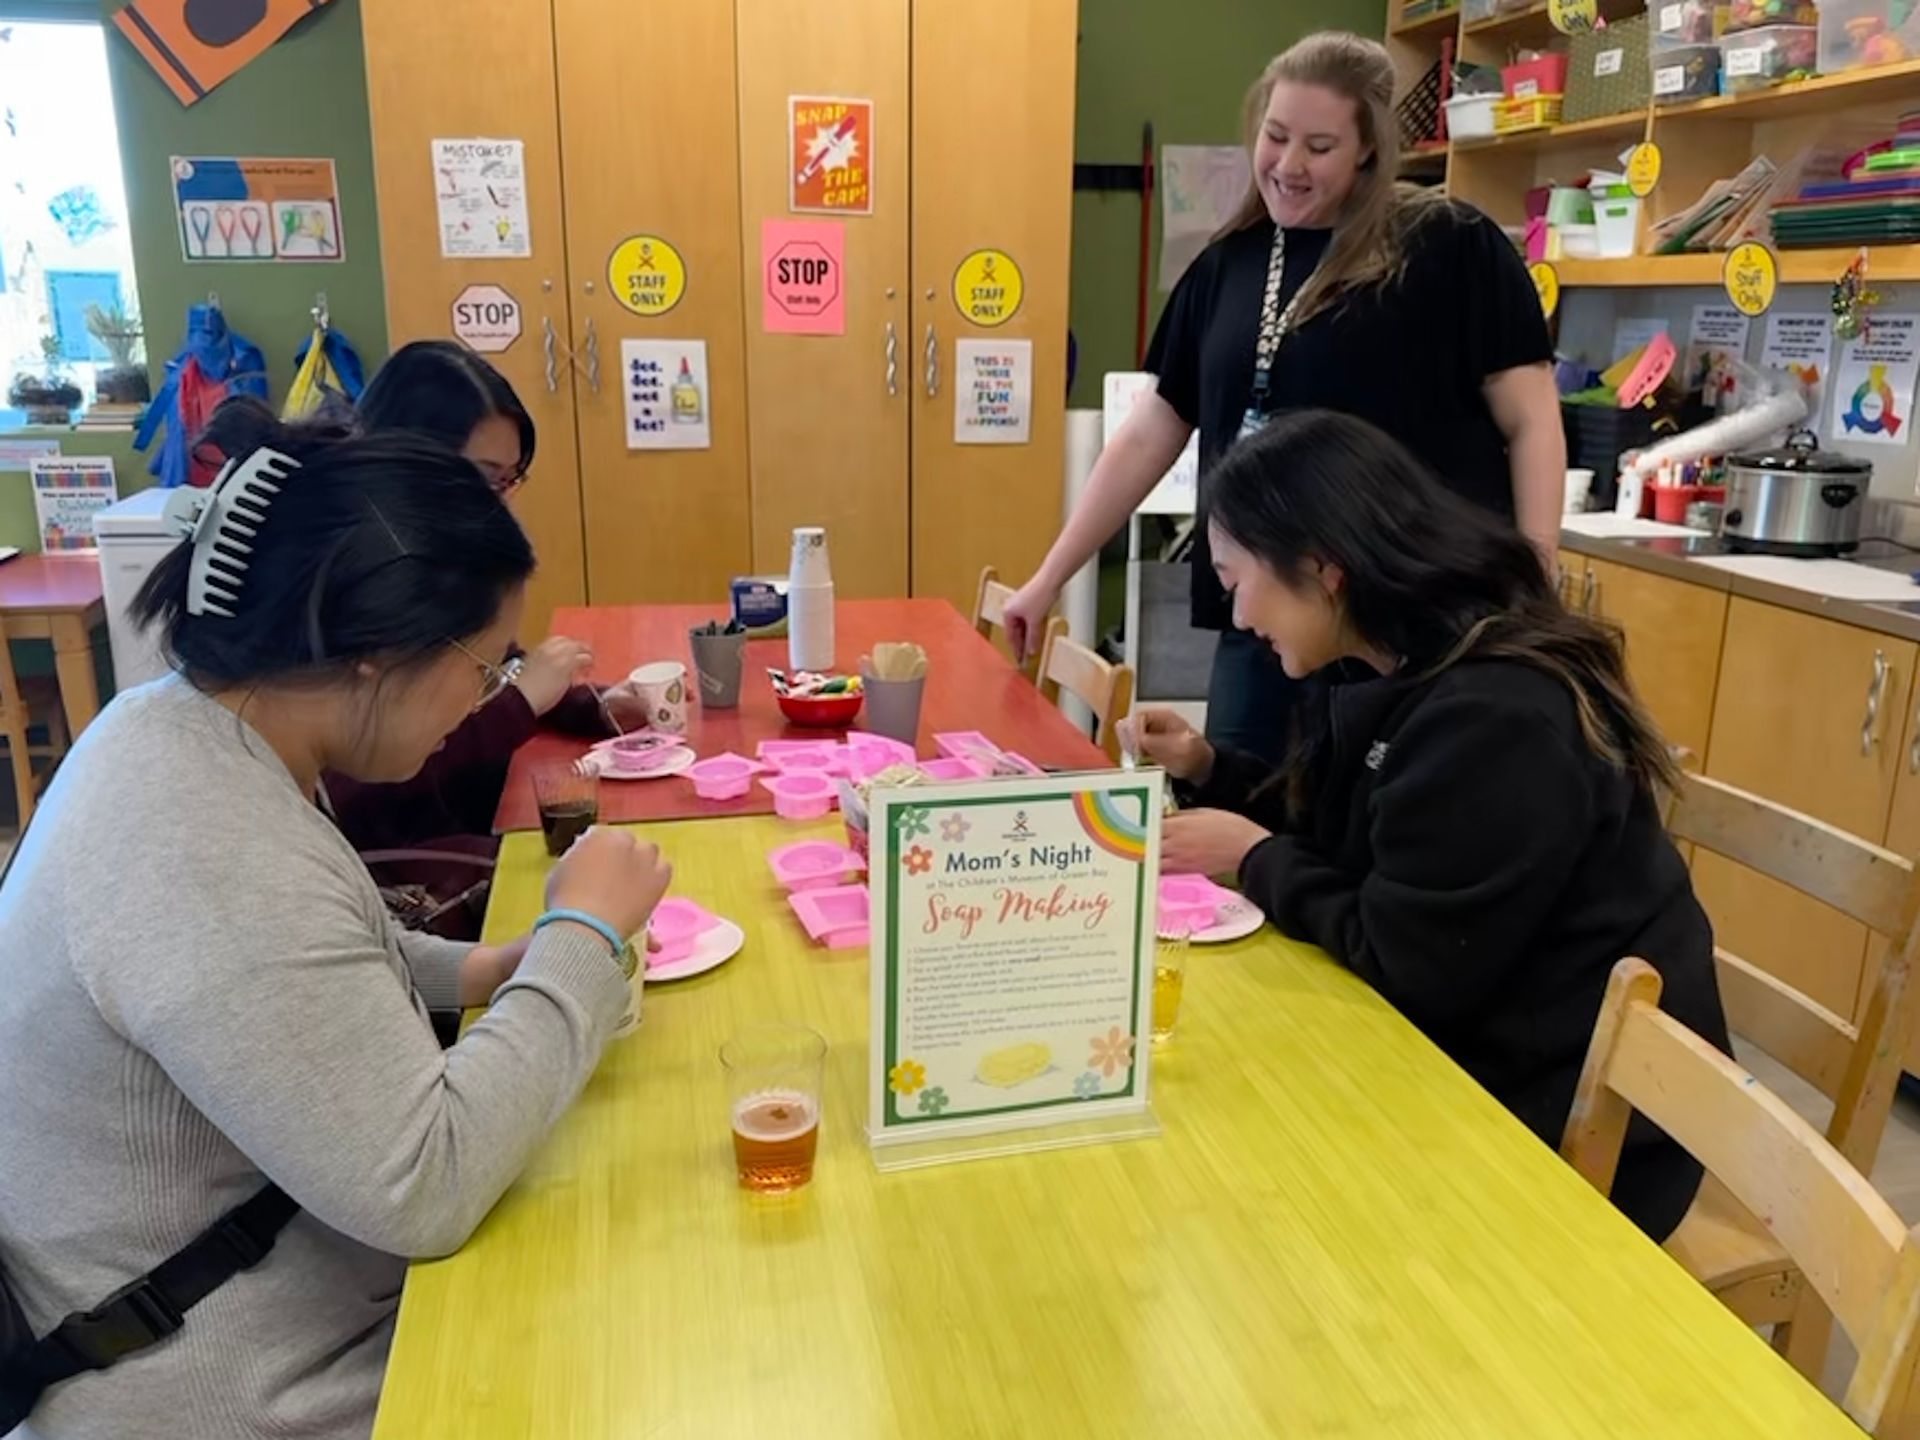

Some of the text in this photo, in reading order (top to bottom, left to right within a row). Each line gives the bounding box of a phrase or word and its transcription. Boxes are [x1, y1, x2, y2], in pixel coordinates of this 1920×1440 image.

[796, 105, 847, 126] SNAP
[823, 168, 863, 188] THE
[822, 185, 868, 206] CAP!
[778, 257, 829, 285] STOP
[628, 275, 667, 289] STAFF
[630, 292, 666, 306] ONLY
[971, 287, 1006, 301] STAFF
[457, 303, 514, 325] STOP
[972, 304, 1004, 318] ONLY
[974, 356, 1015, 366] THIS IS
[977, 369, 1011, 379] WHERE
[974, 381, 1014, 390] ALL THE
[977, 391, 1010, 404] FUN
[978, 405, 1009, 416] STUFF
[945, 843, 1093, 872] Mom's Night
[937, 880, 955, 889] The
[958, 875, 1005, 888] Children's
[1008, 873, 1045, 884] Museum
[1048, 873, 1058, 881] of
[1061, 871, 1089, 880] Green
[1092, 869, 1109, 879] Bay
[922, 884, 1114, 939] Soap Making
